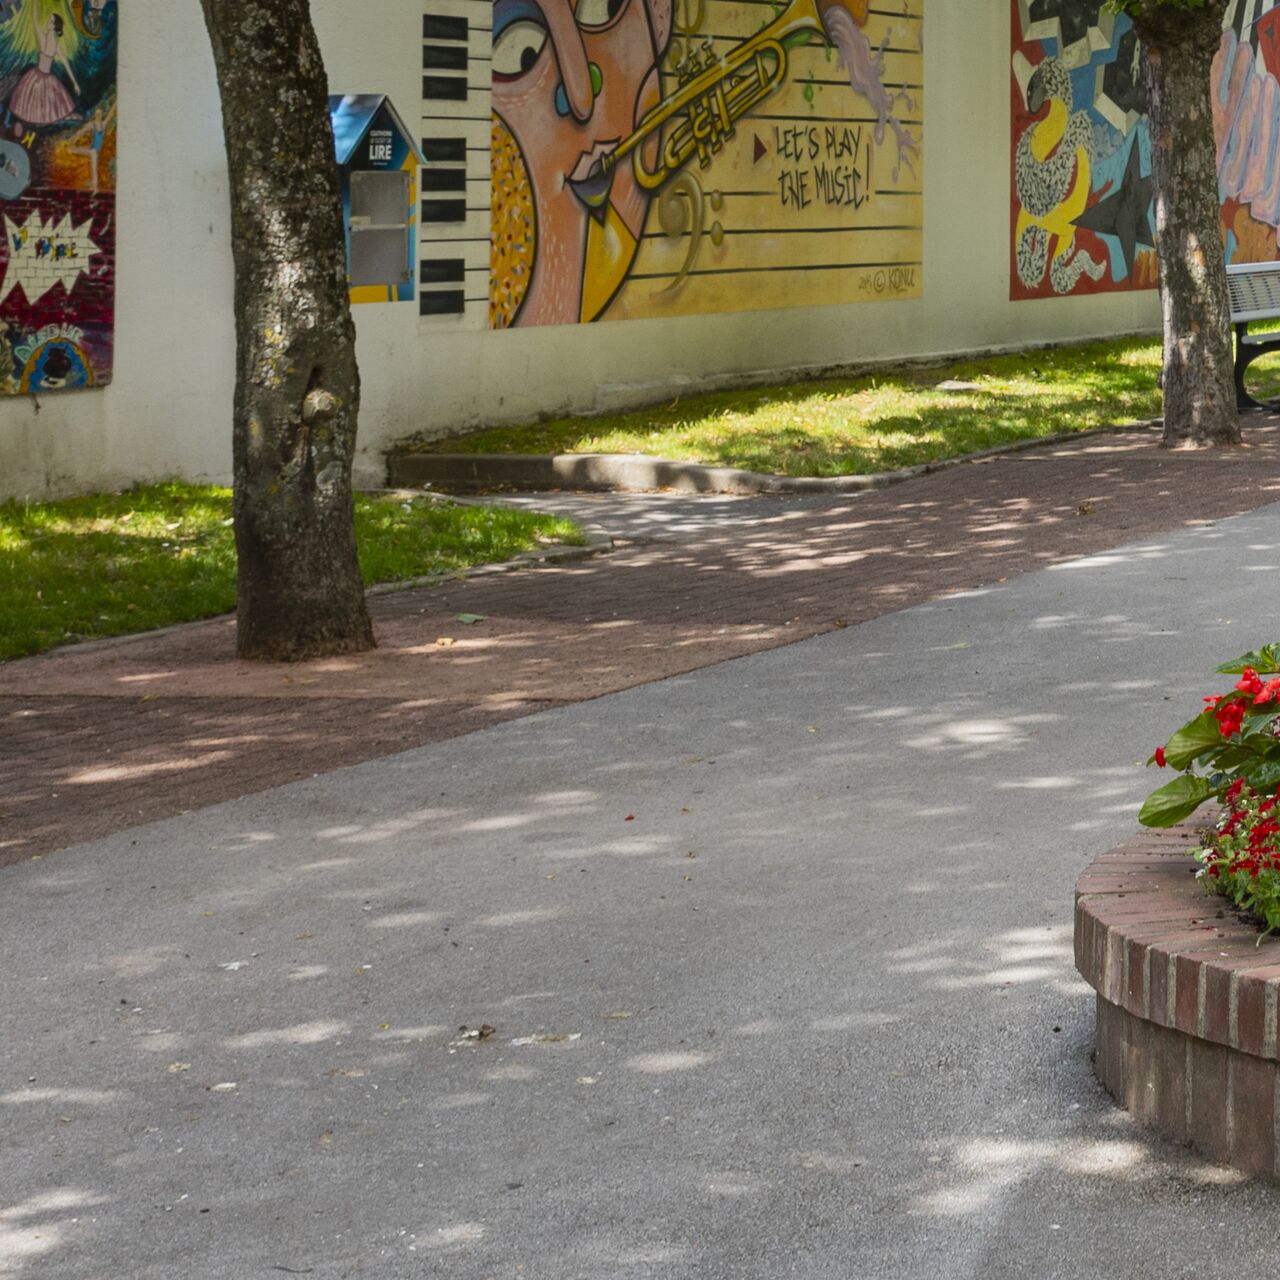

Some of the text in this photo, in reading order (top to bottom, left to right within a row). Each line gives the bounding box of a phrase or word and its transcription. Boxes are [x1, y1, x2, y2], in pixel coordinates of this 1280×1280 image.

[369, 145, 393, 160] LIRE
[776, 125, 861, 164] LET'S PLAY
[778, 168, 812, 211] THE
